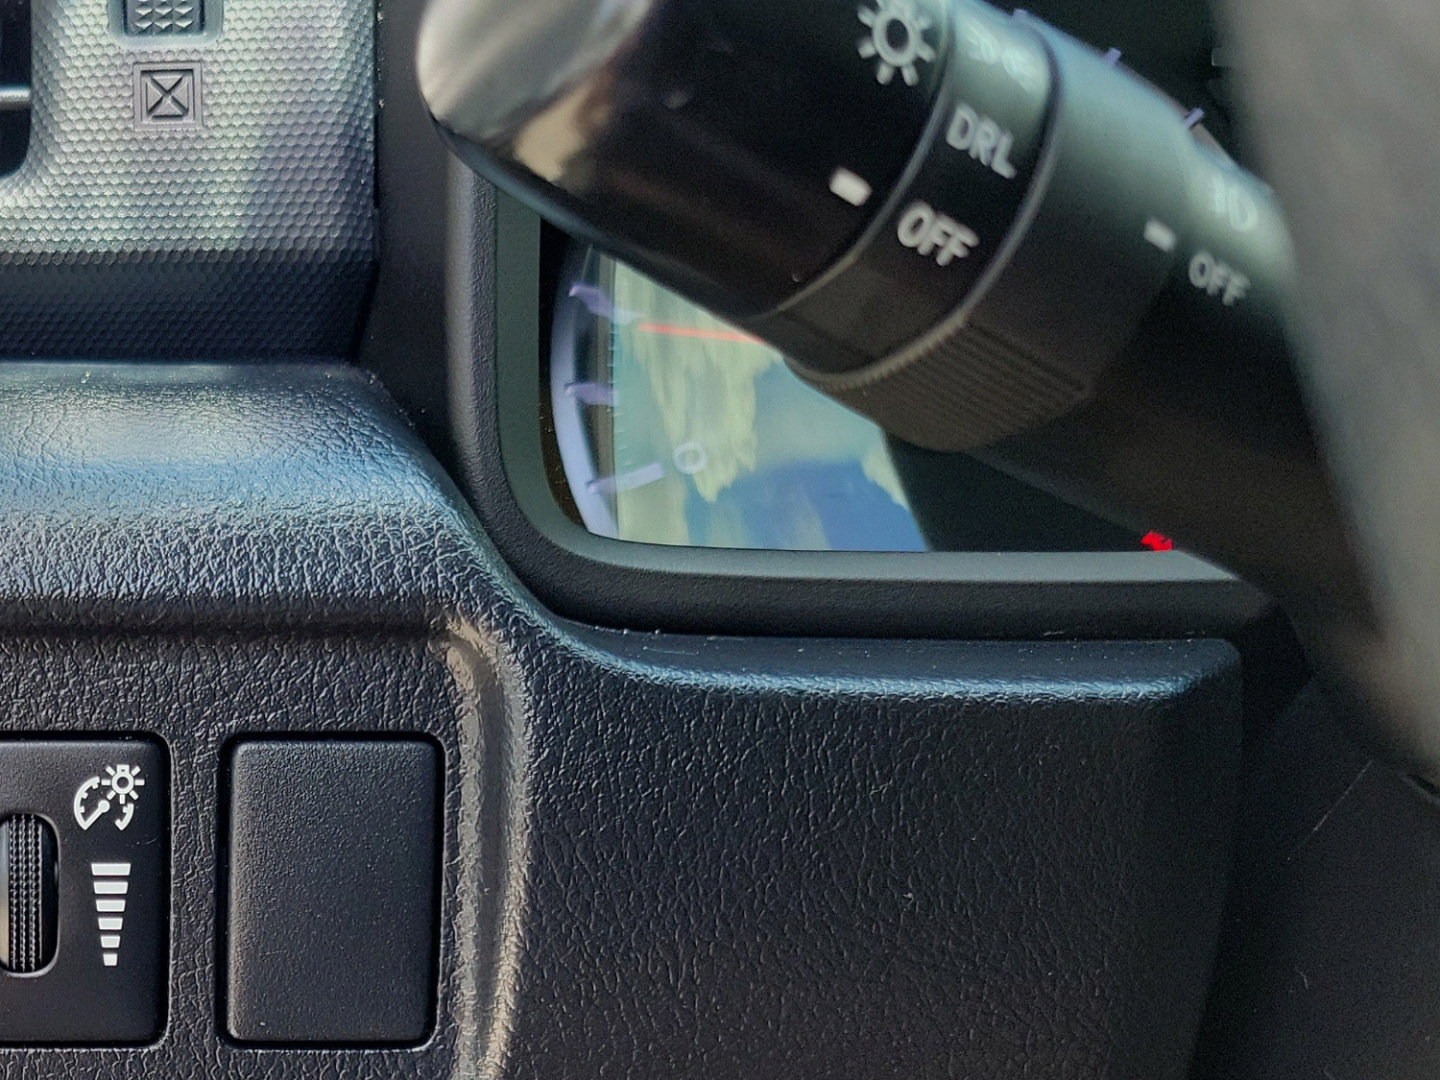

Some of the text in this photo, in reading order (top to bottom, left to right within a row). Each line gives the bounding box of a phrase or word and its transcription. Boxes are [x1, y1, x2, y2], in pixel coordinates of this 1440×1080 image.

[947, 103, 1017, 180] DRL
[897, 200, 980, 267] OFF
[1188, 251, 1251, 306] OFF
